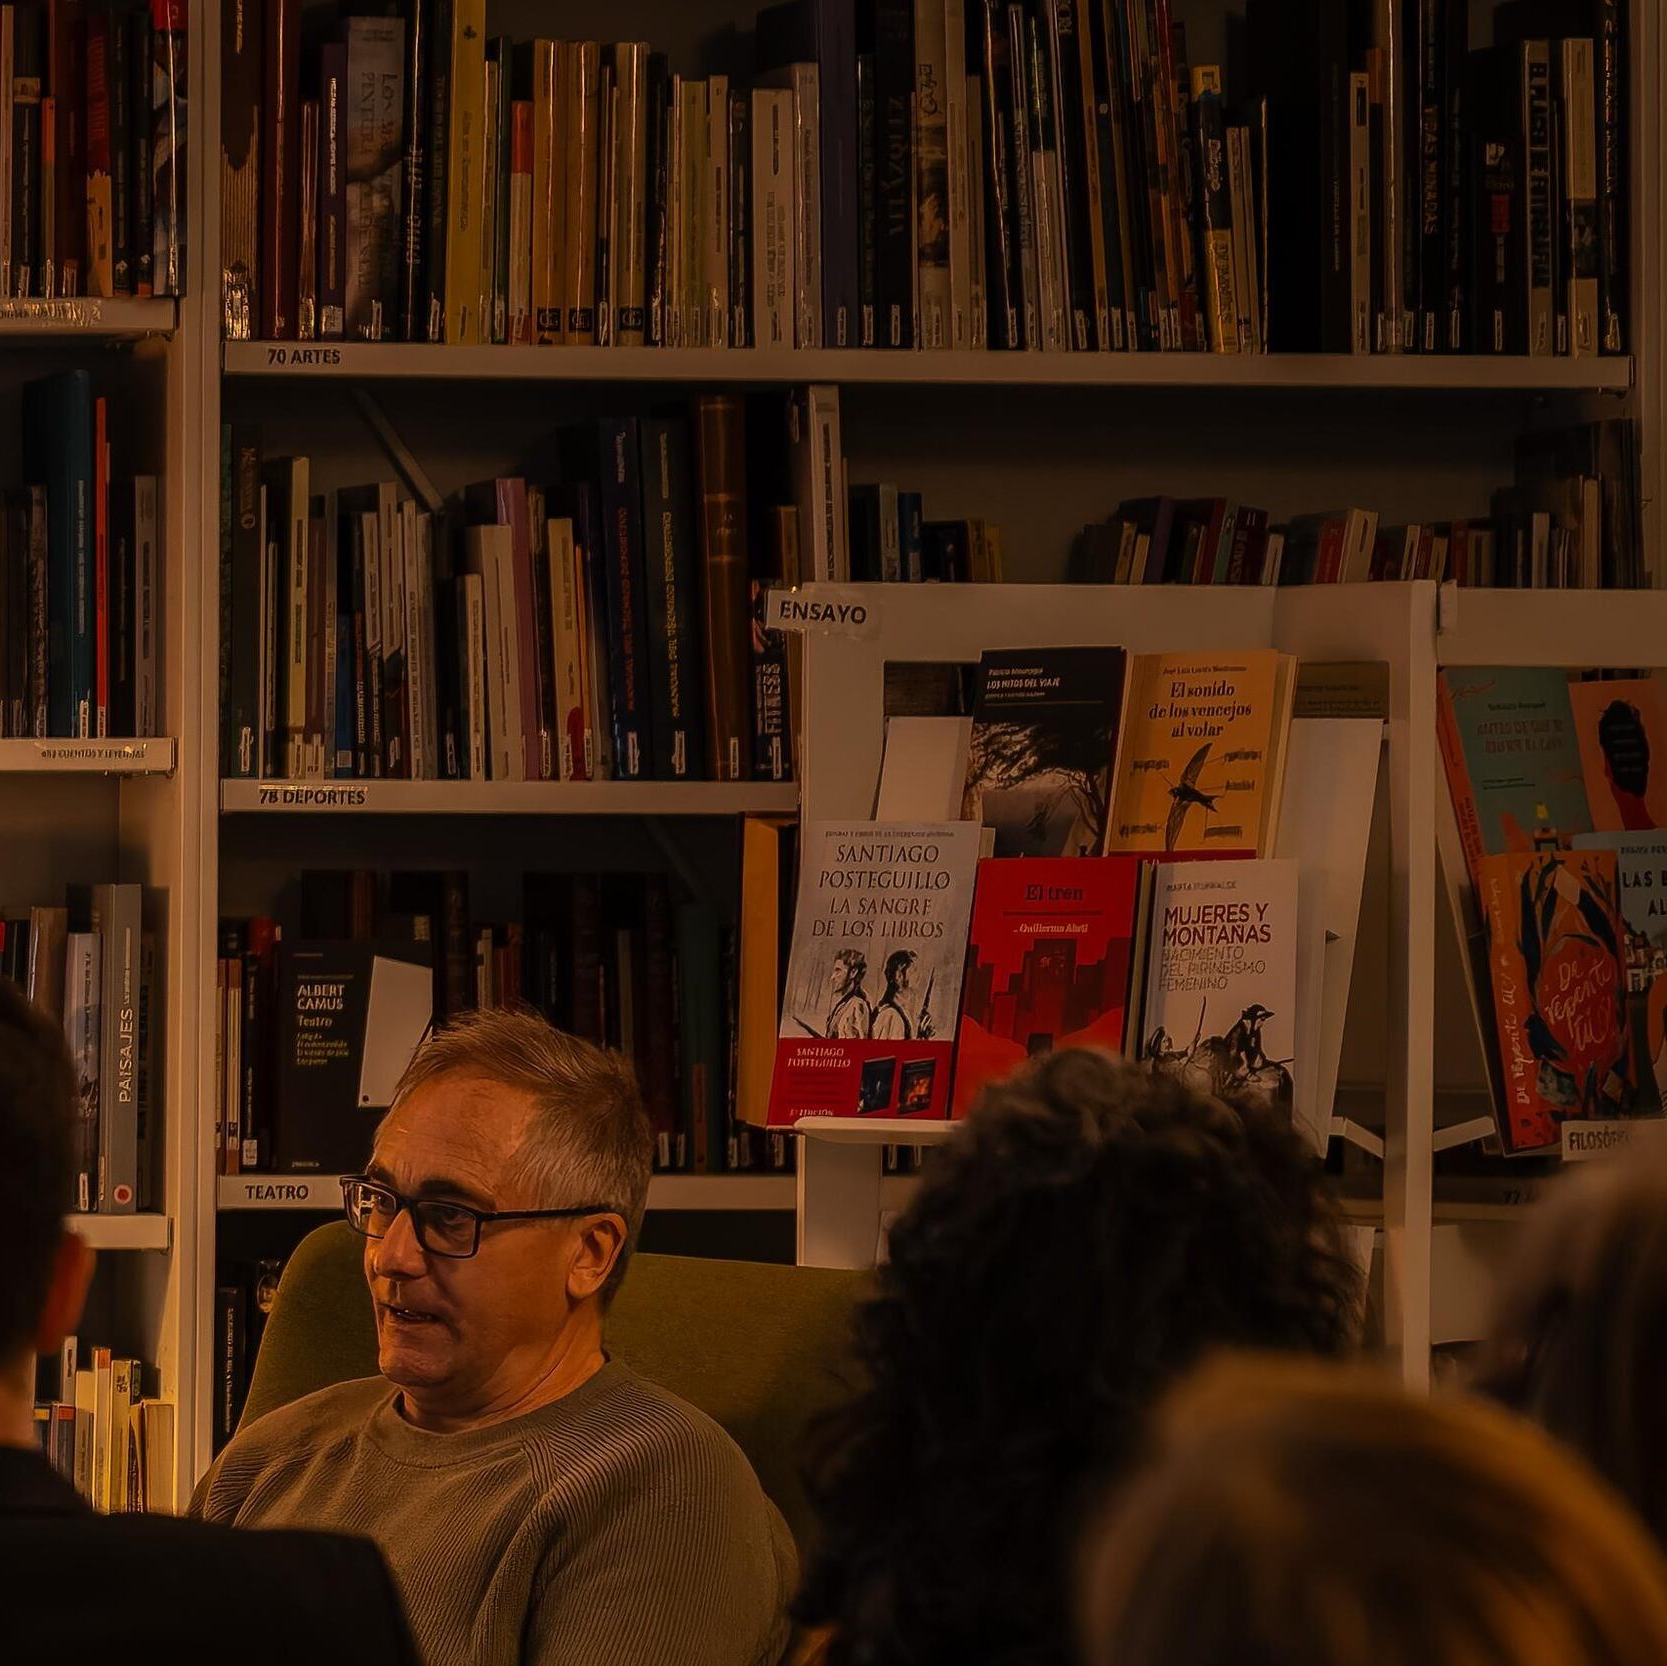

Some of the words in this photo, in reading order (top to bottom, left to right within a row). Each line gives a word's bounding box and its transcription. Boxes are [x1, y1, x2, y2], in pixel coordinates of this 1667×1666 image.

[268, 349, 286, 364] 70
[291, 349, 340, 364] ARTES
[780, 601, 866, 624] ENSAYO
[762, 662, 781, 734] FITNESS
[1170, 682, 1185, 698] El
[1187, 680, 1235, 698] sonido
[1149, 706, 1167, 720] de
[1169, 703, 1188, 720] los
[1191, 701, 1252, 722] vencejos
[1172, 724, 1185, 738] al
[1188, 723, 1223, 738] volar
[283, 790, 365, 805] DEPORTES
[836, 845, 939, 864] SANTIAGO
[819, 870, 951, 891] POSTEGUILLO
[1622, 870, 1652, 888] LAS
[1027, 884, 1043, 900] El
[1048, 886, 1083, 901] tren
[830, 897, 851, 914] LA
[858, 897, 931, 916] SANGRE
[1165, 904, 1250, 926] MUJERES
[1255, 902, 1269, 921] Y
[812, 919, 835, 937] DE
[841, 921, 873, 937] LOS
[881, 920, 943, 938] LIBROS
[1163, 924, 1272, 947] MONTAÑAS
[297, 984, 345, 998] ALBERT
[297, 998, 343, 1011] CAMUS
[118, 1007, 133, 1103] PAISAJES
[245, 1185, 309, 1200] TEATRO
